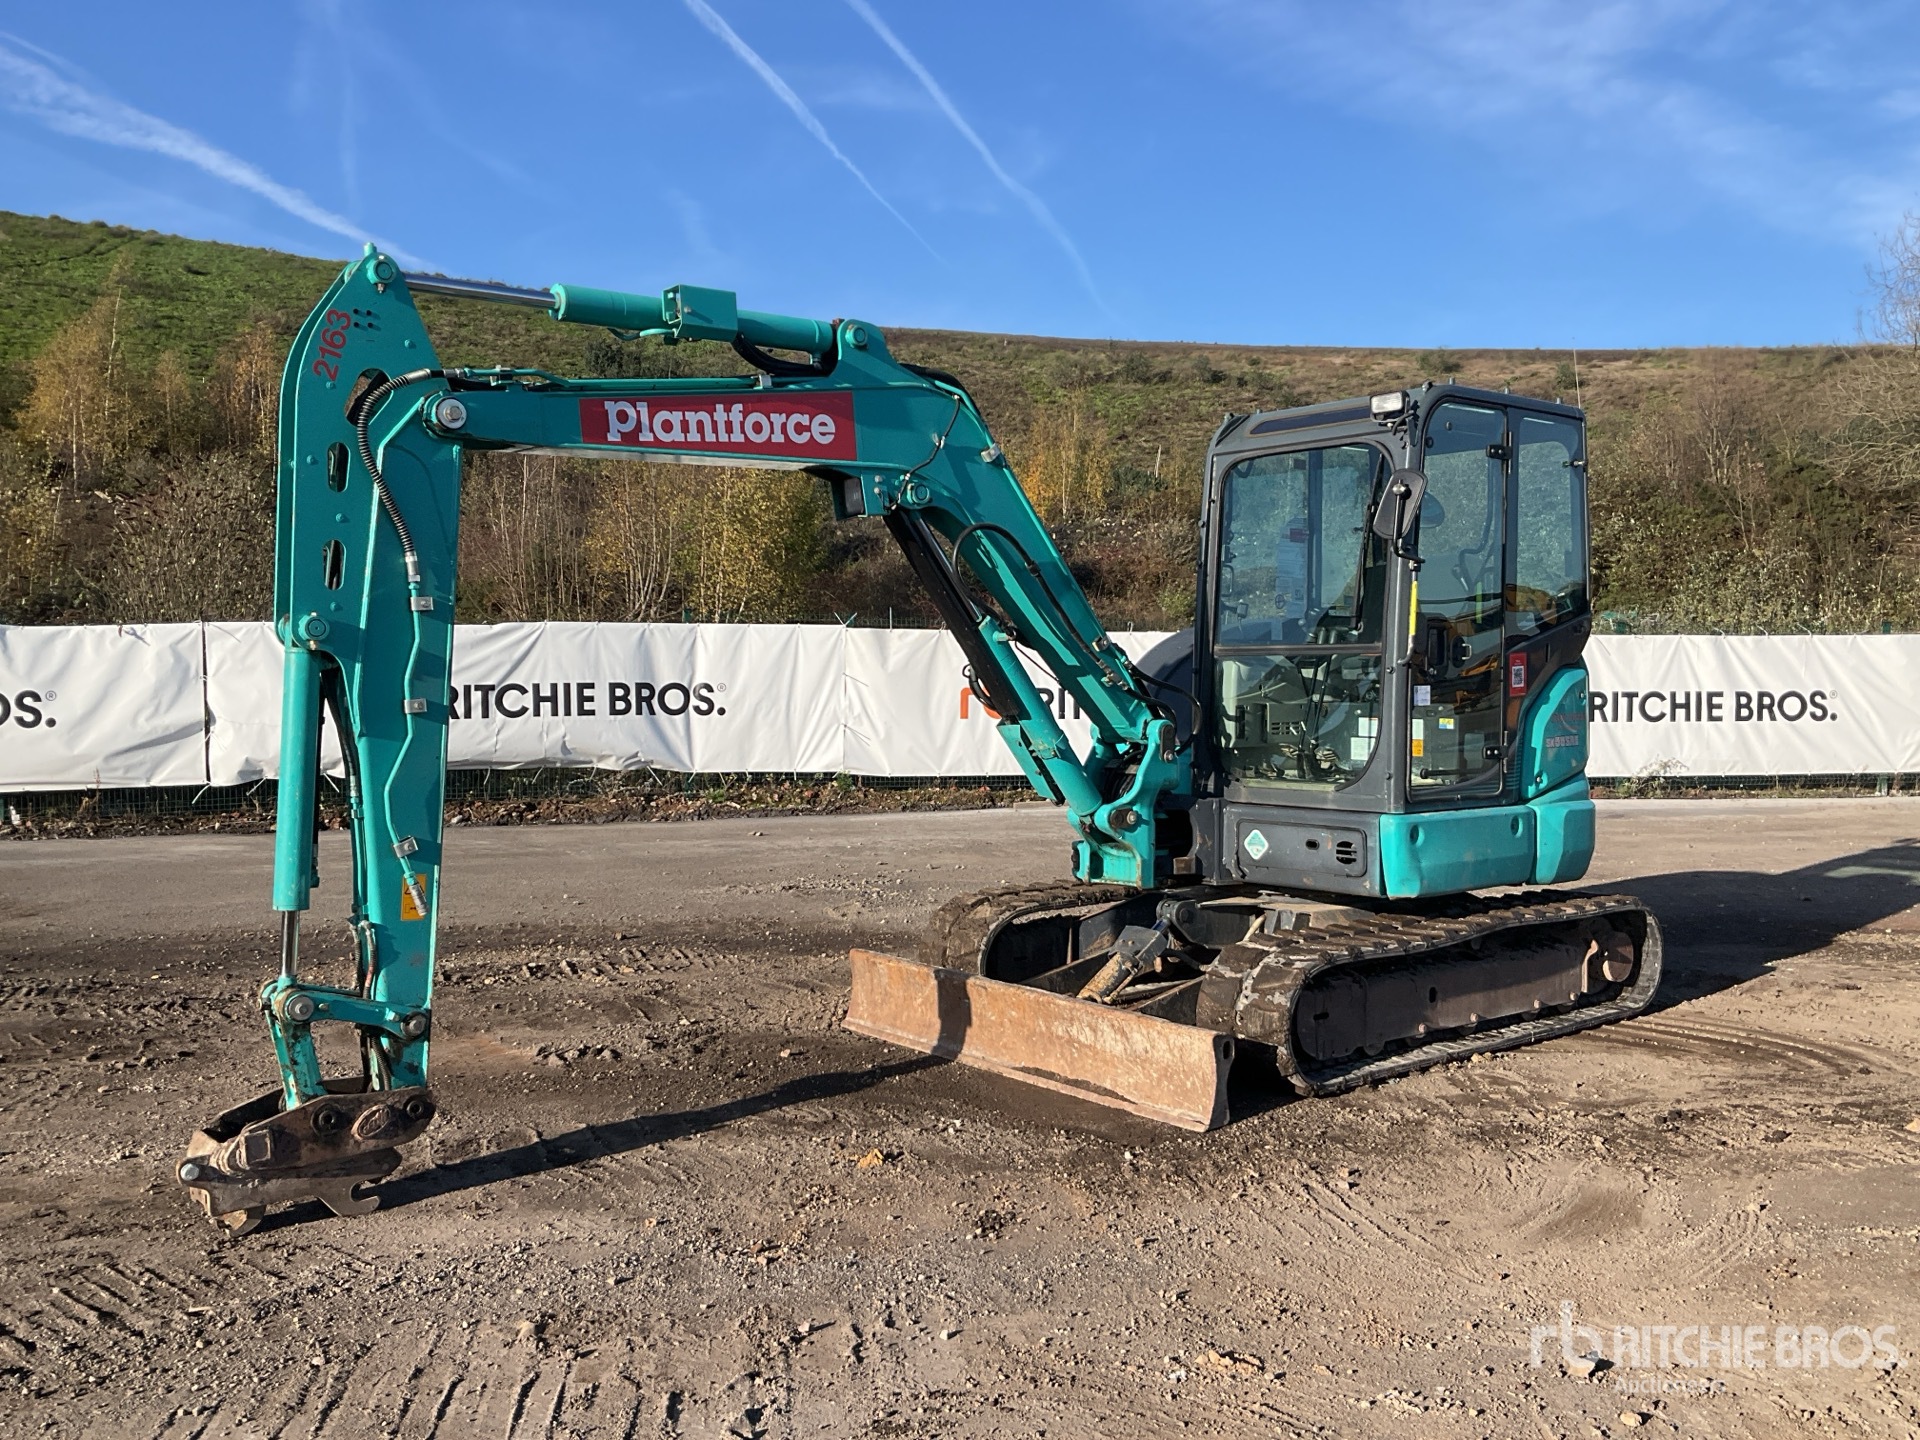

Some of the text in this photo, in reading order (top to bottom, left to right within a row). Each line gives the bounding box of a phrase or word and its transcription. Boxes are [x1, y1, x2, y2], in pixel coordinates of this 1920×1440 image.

[313, 308, 351, 381] 2163
[0, 690, 57, 728] S.
[1589, 690, 1724, 723] RITCHIE
